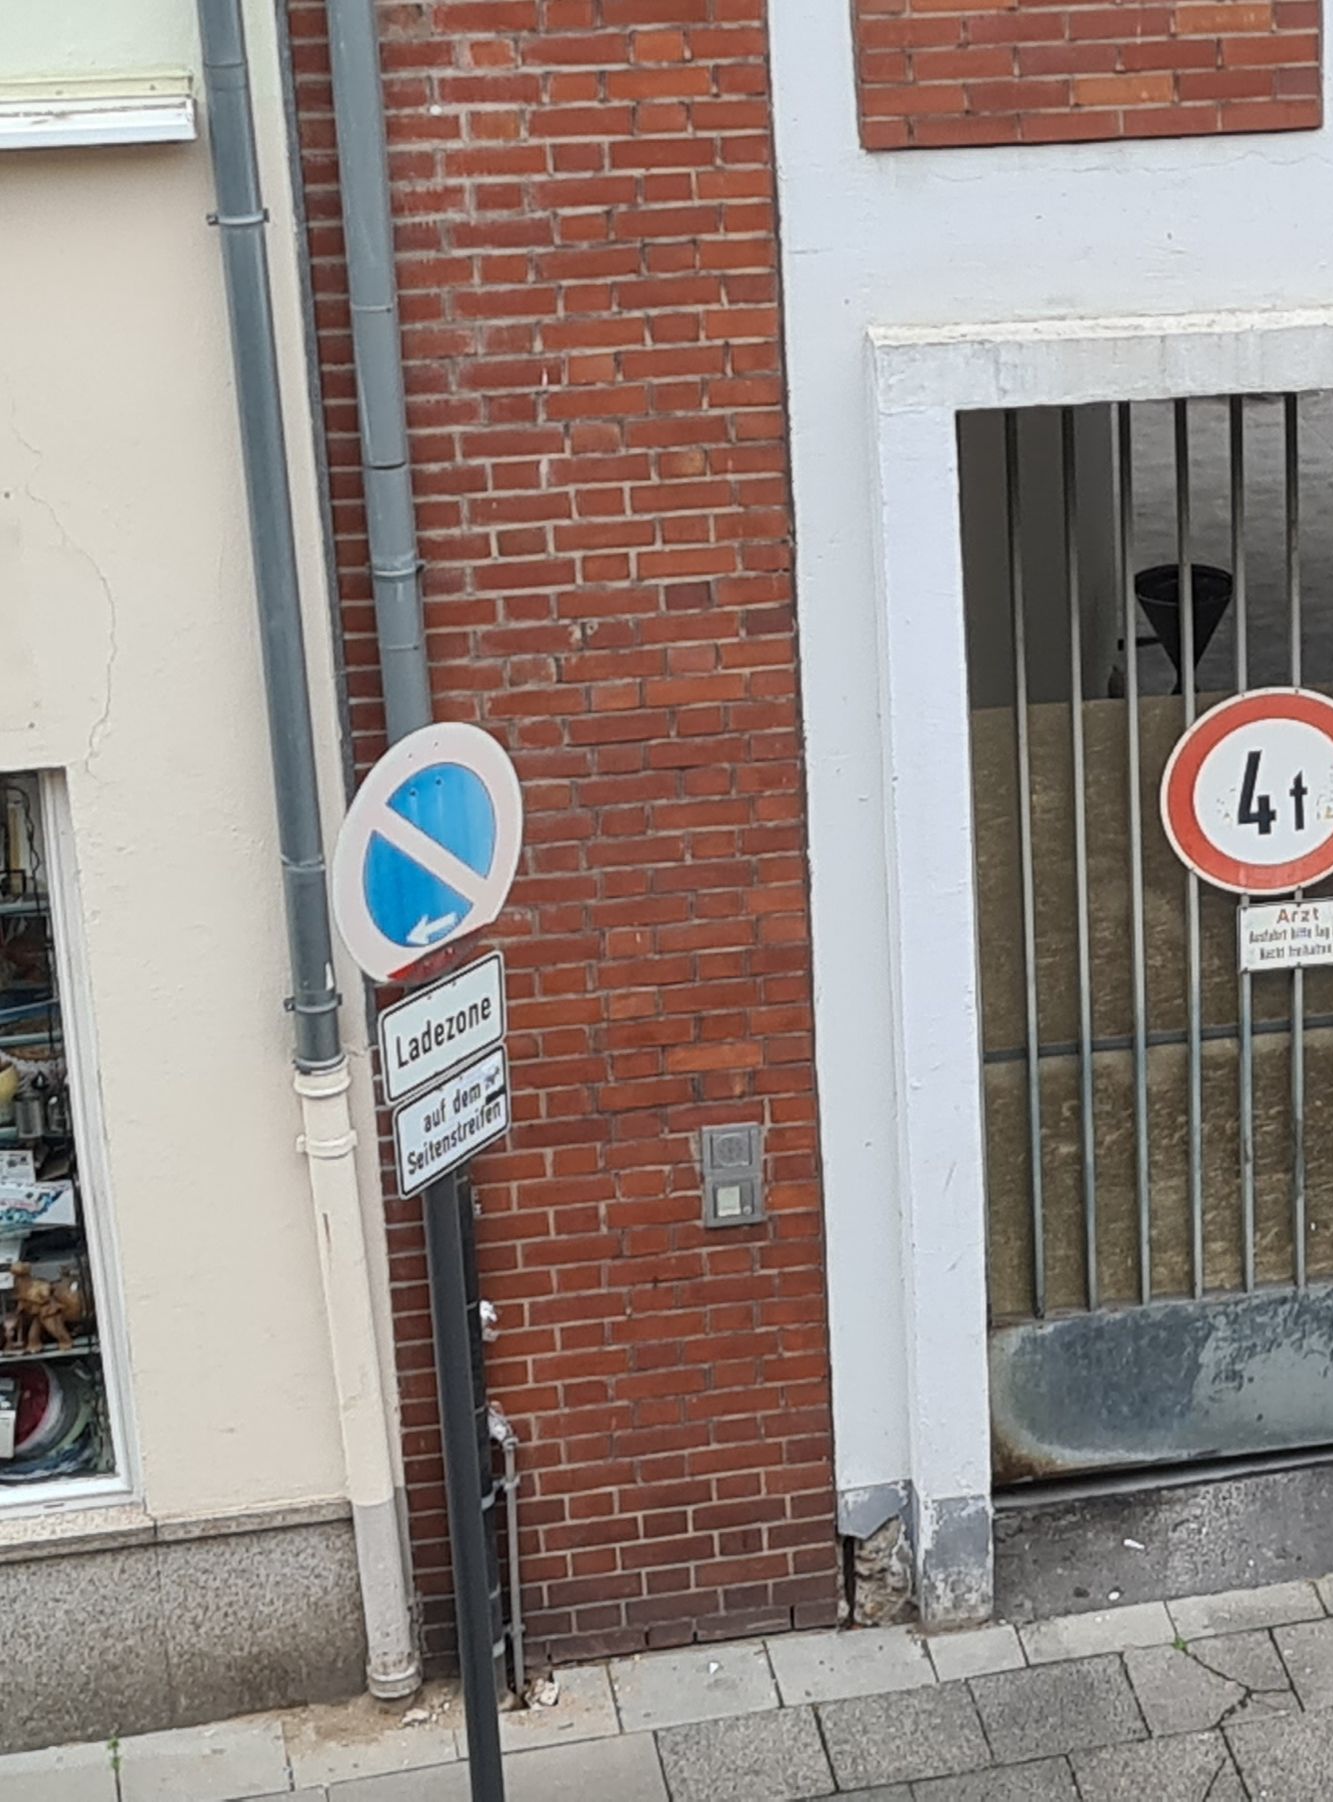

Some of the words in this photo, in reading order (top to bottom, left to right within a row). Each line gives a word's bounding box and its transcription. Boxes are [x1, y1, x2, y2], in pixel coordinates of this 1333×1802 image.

[1238, 750, 1276, 836] 4
[1289, 769, 1308, 831] t
[1276, 906, 1320, 924] Arzt
[395, 996, 493, 1070] Ladezone
[406, 1100, 501, 1176] Seitenstreifen
[423, 1098, 448, 1134] auf
[452, 1081, 482, 1115] dem
